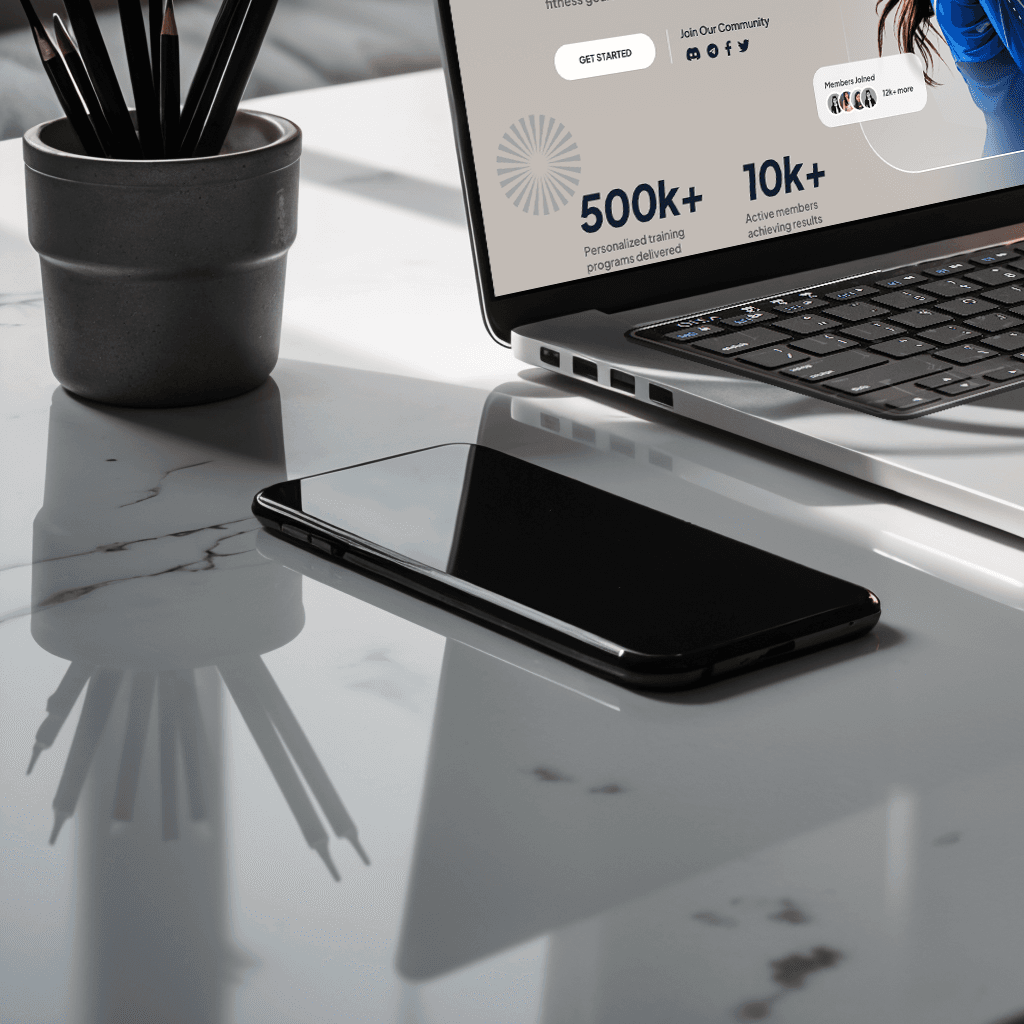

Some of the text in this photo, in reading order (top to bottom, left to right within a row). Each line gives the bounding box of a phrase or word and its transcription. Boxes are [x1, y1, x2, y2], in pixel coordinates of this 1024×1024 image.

[680, 17, 769, 39] Join Our Community
[579, 49, 632, 64] GET STARTED
[825, 74, 875, 89] Members Joined
[898, 86, 913, 94] more
[743, 156, 825, 201] 10k+
[581, 180, 702, 233] 500k+
[746, 201, 818, 223] Active members
[748, 216, 822, 238] achieving results
[584, 229, 685, 257] Personalized training
[587, 244, 681, 274] programs delivered
